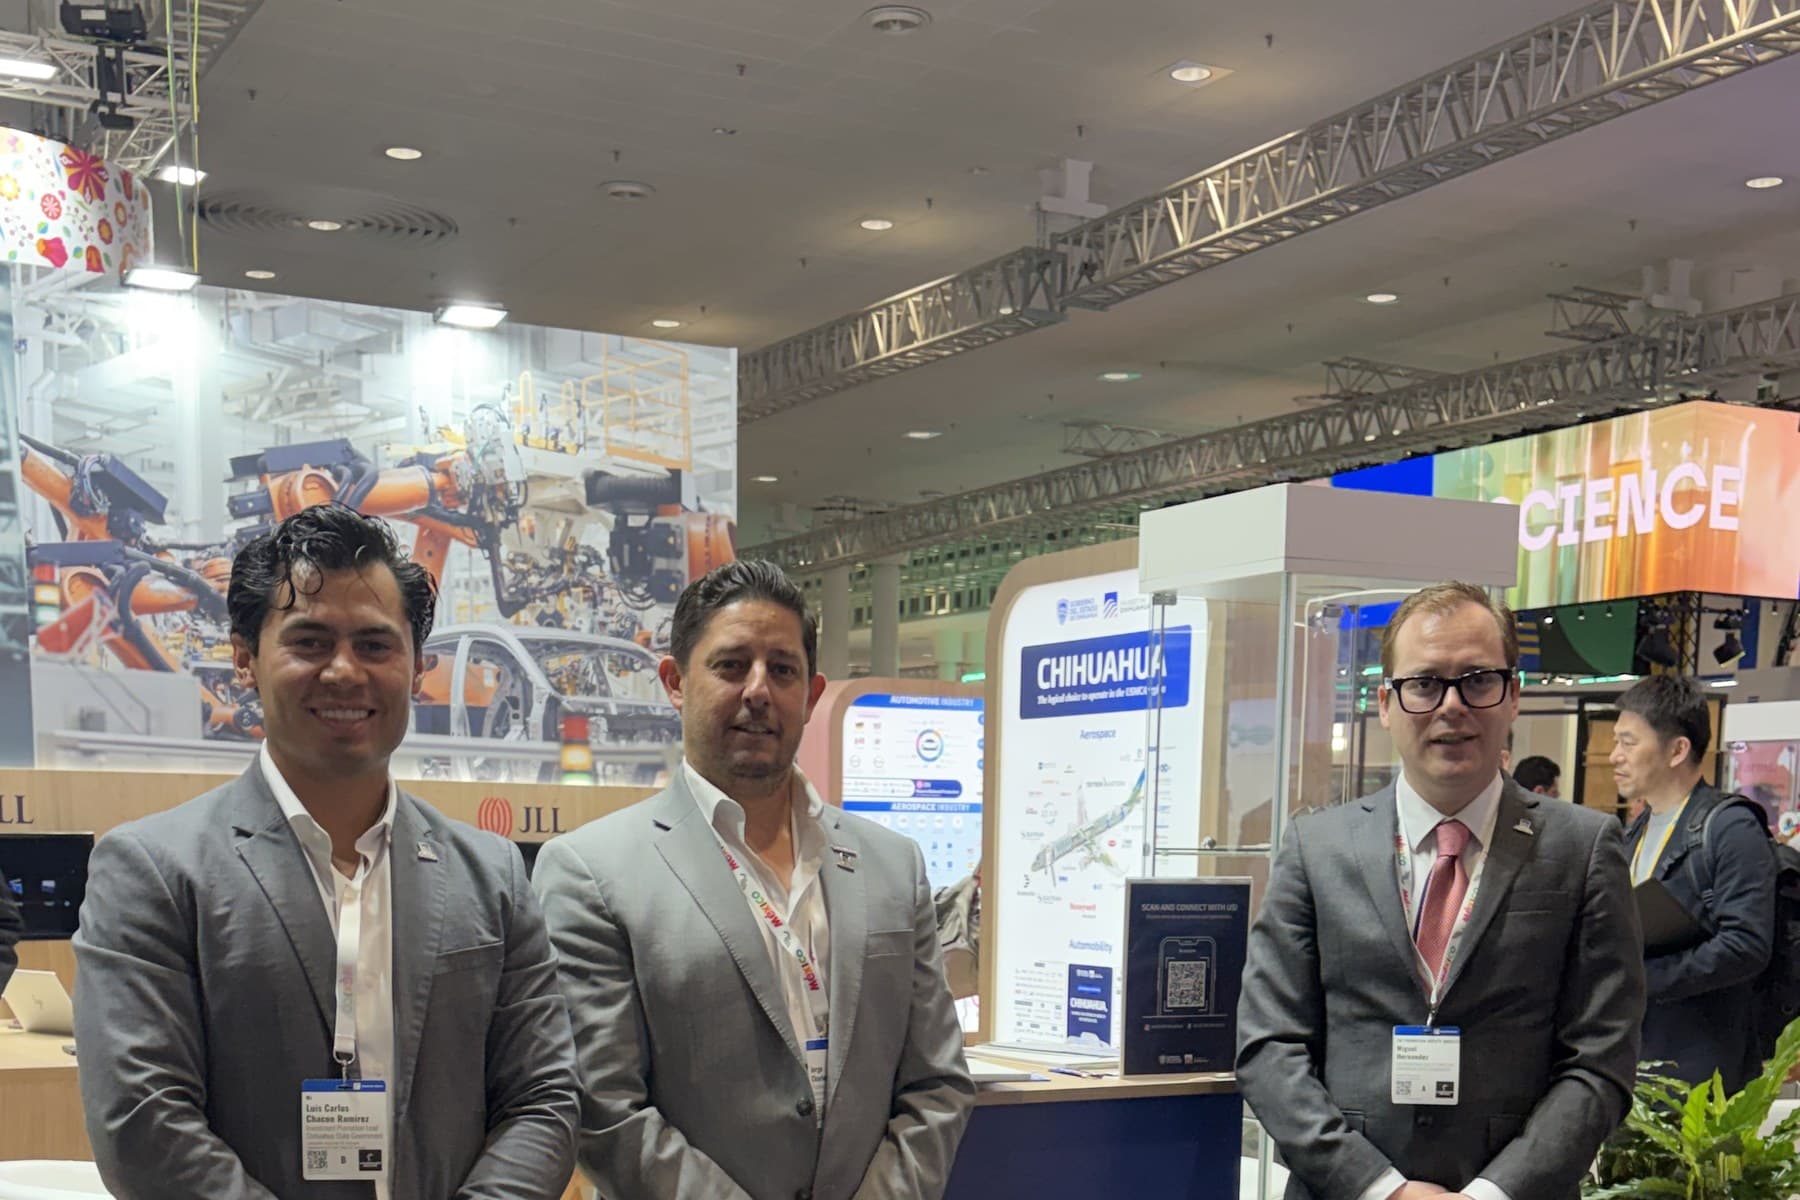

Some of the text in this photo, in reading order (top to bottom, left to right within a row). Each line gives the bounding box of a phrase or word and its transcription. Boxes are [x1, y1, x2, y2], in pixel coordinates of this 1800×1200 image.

[1491, 461, 1741, 551] CIENCE
[1037, 645, 1167, 689] CHIHUAHUA
[1080, 729, 1117, 741] Aerospace
[0, 794, 34, 825] LL
[520, 806, 567, 833] JLL
[1069, 940, 1113, 954] Automobility
[306, 1103, 349, 1112] Luis Carlos
